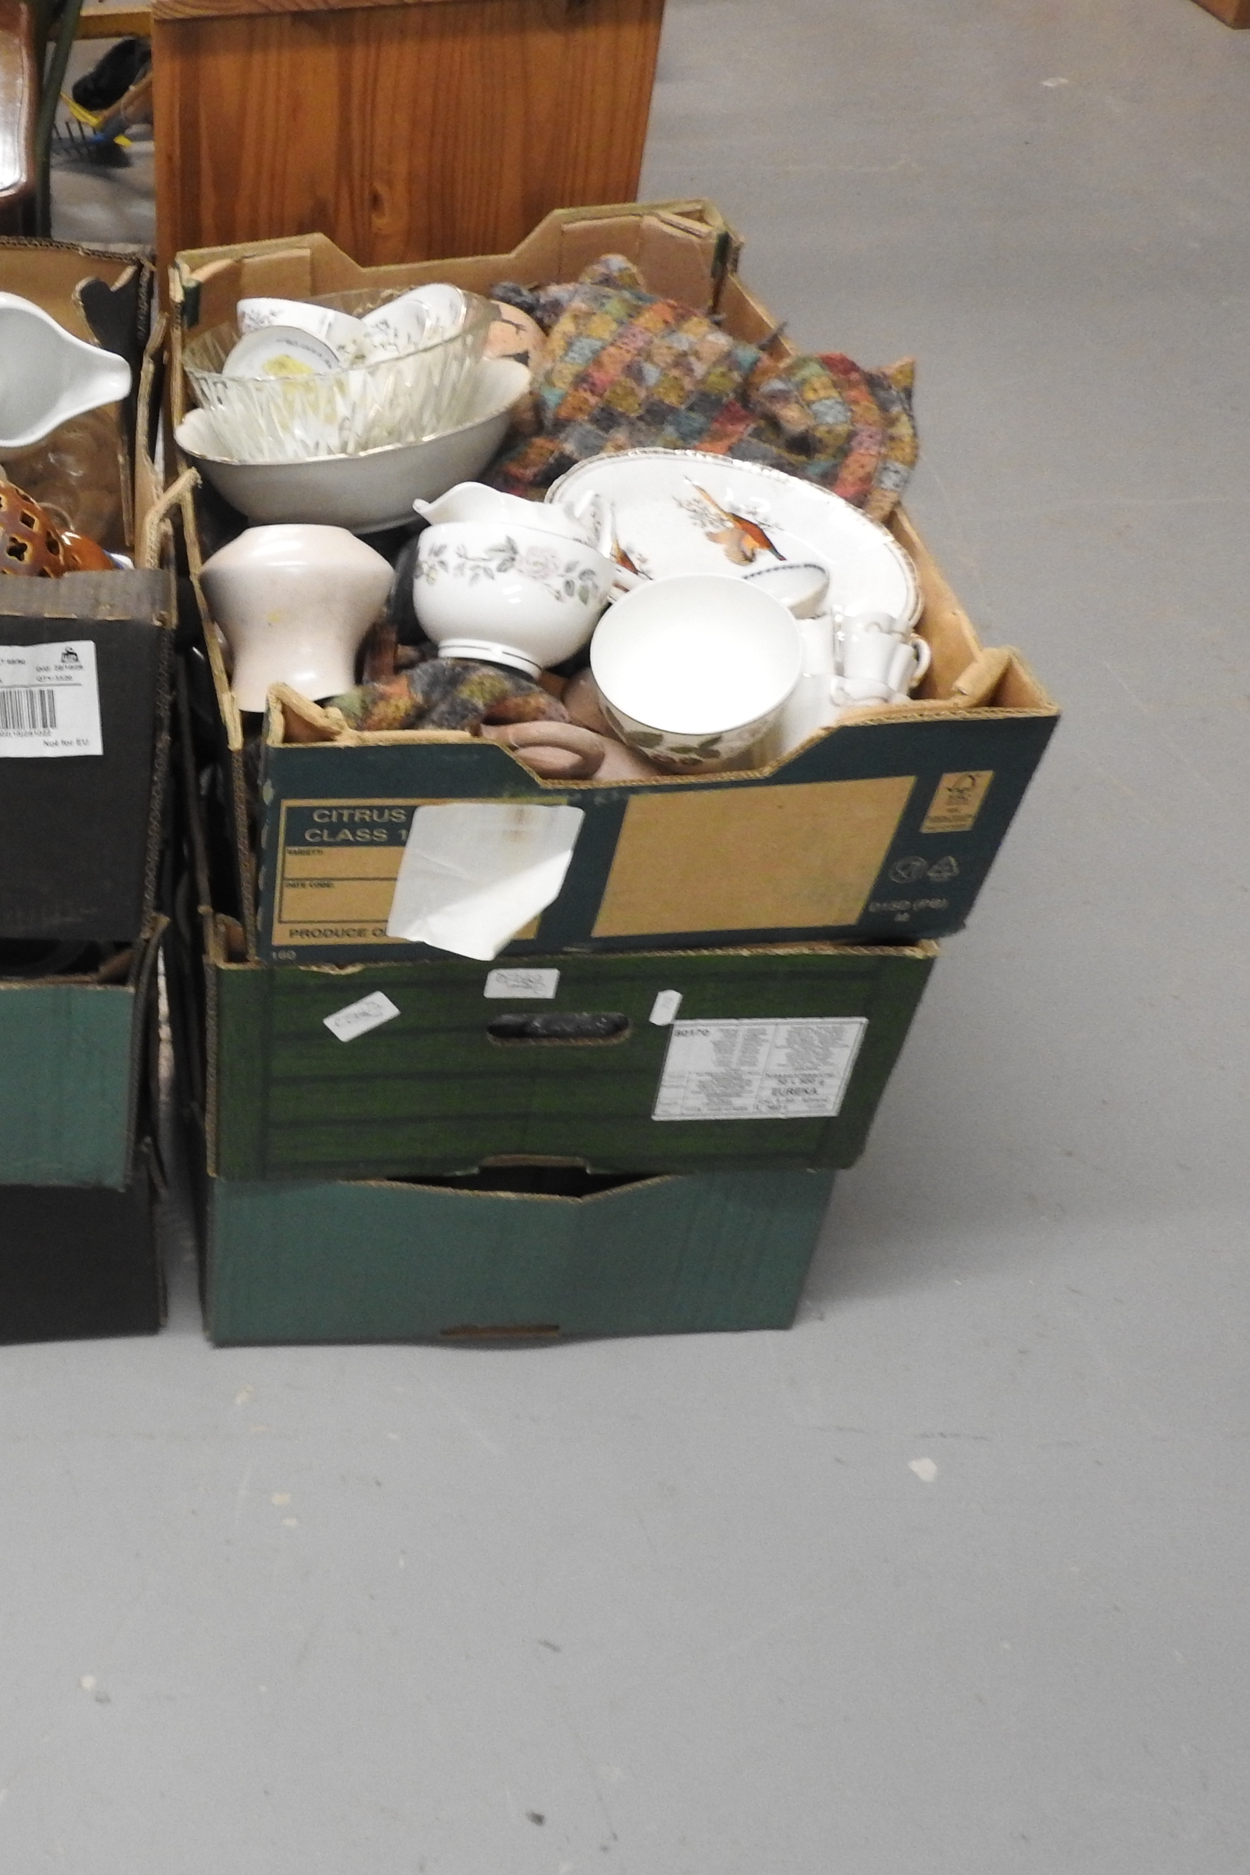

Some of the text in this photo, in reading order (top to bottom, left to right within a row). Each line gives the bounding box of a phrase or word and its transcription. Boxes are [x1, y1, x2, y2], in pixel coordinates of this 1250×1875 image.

[312, 808, 407, 823] CITRUS
[304, 828, 388, 842] CLASS
[288, 927, 387, 939] PRODUCE O
